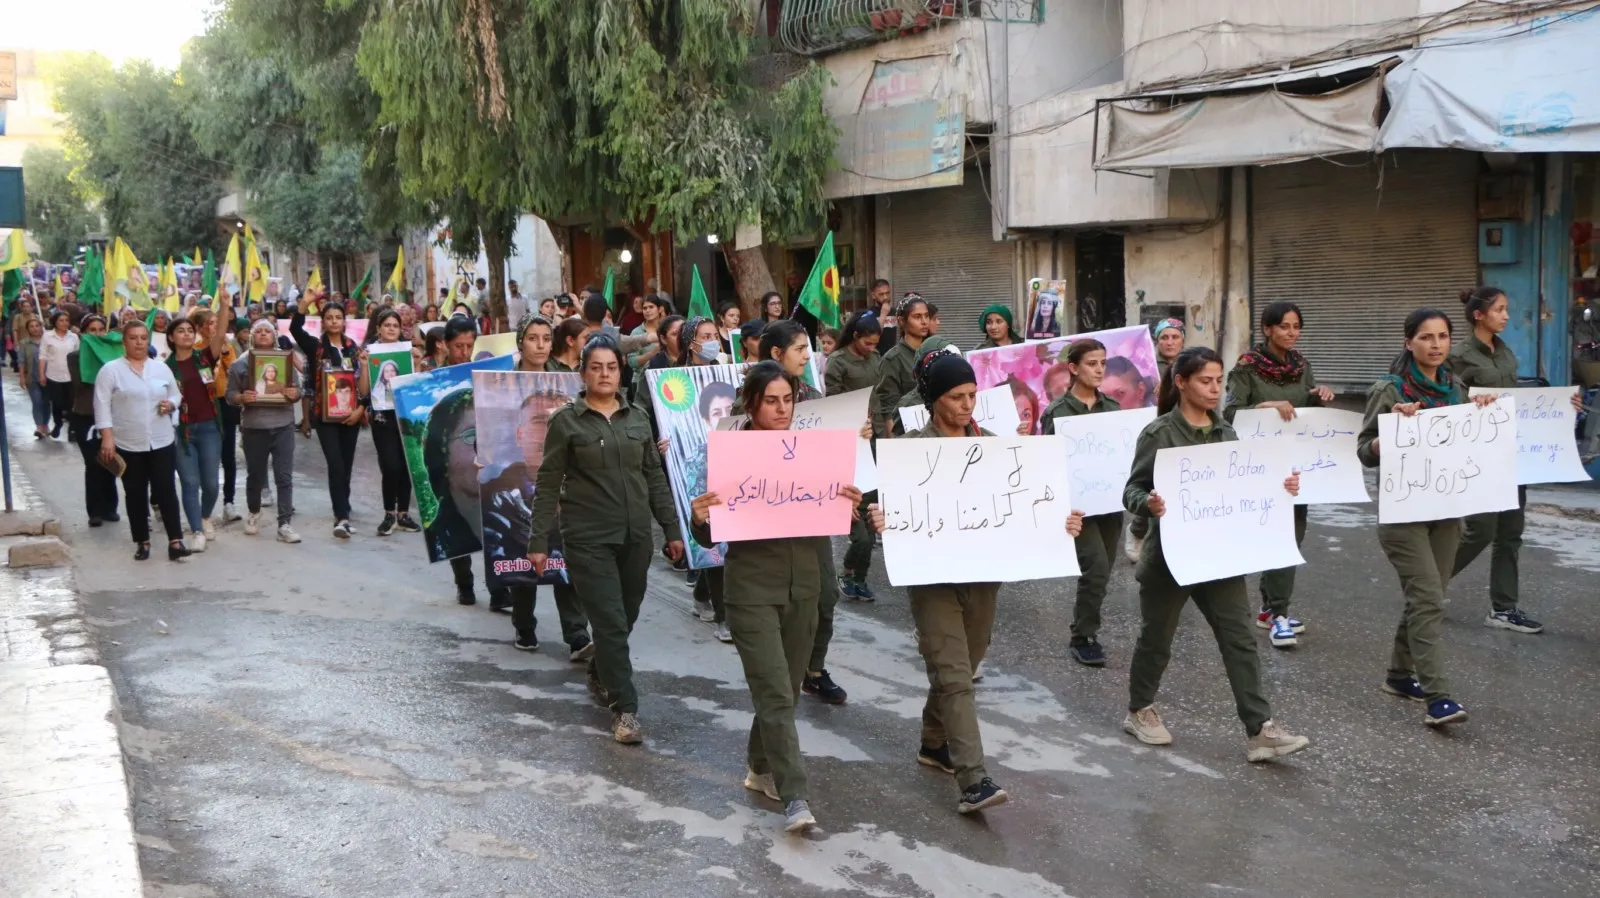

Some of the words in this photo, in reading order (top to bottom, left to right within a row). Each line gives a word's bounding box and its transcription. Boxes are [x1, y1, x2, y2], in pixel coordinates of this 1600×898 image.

[1531, 394, 1564, 420] Botan
[781, 435, 797, 460] لا
[1228, 450, 1266, 479] Botan
[1435, 455, 1481, 496] ثورة
[727, 475, 767, 512] التركي
[1032, 484, 1055, 529] هم
[1239, 498, 1257, 513] me
